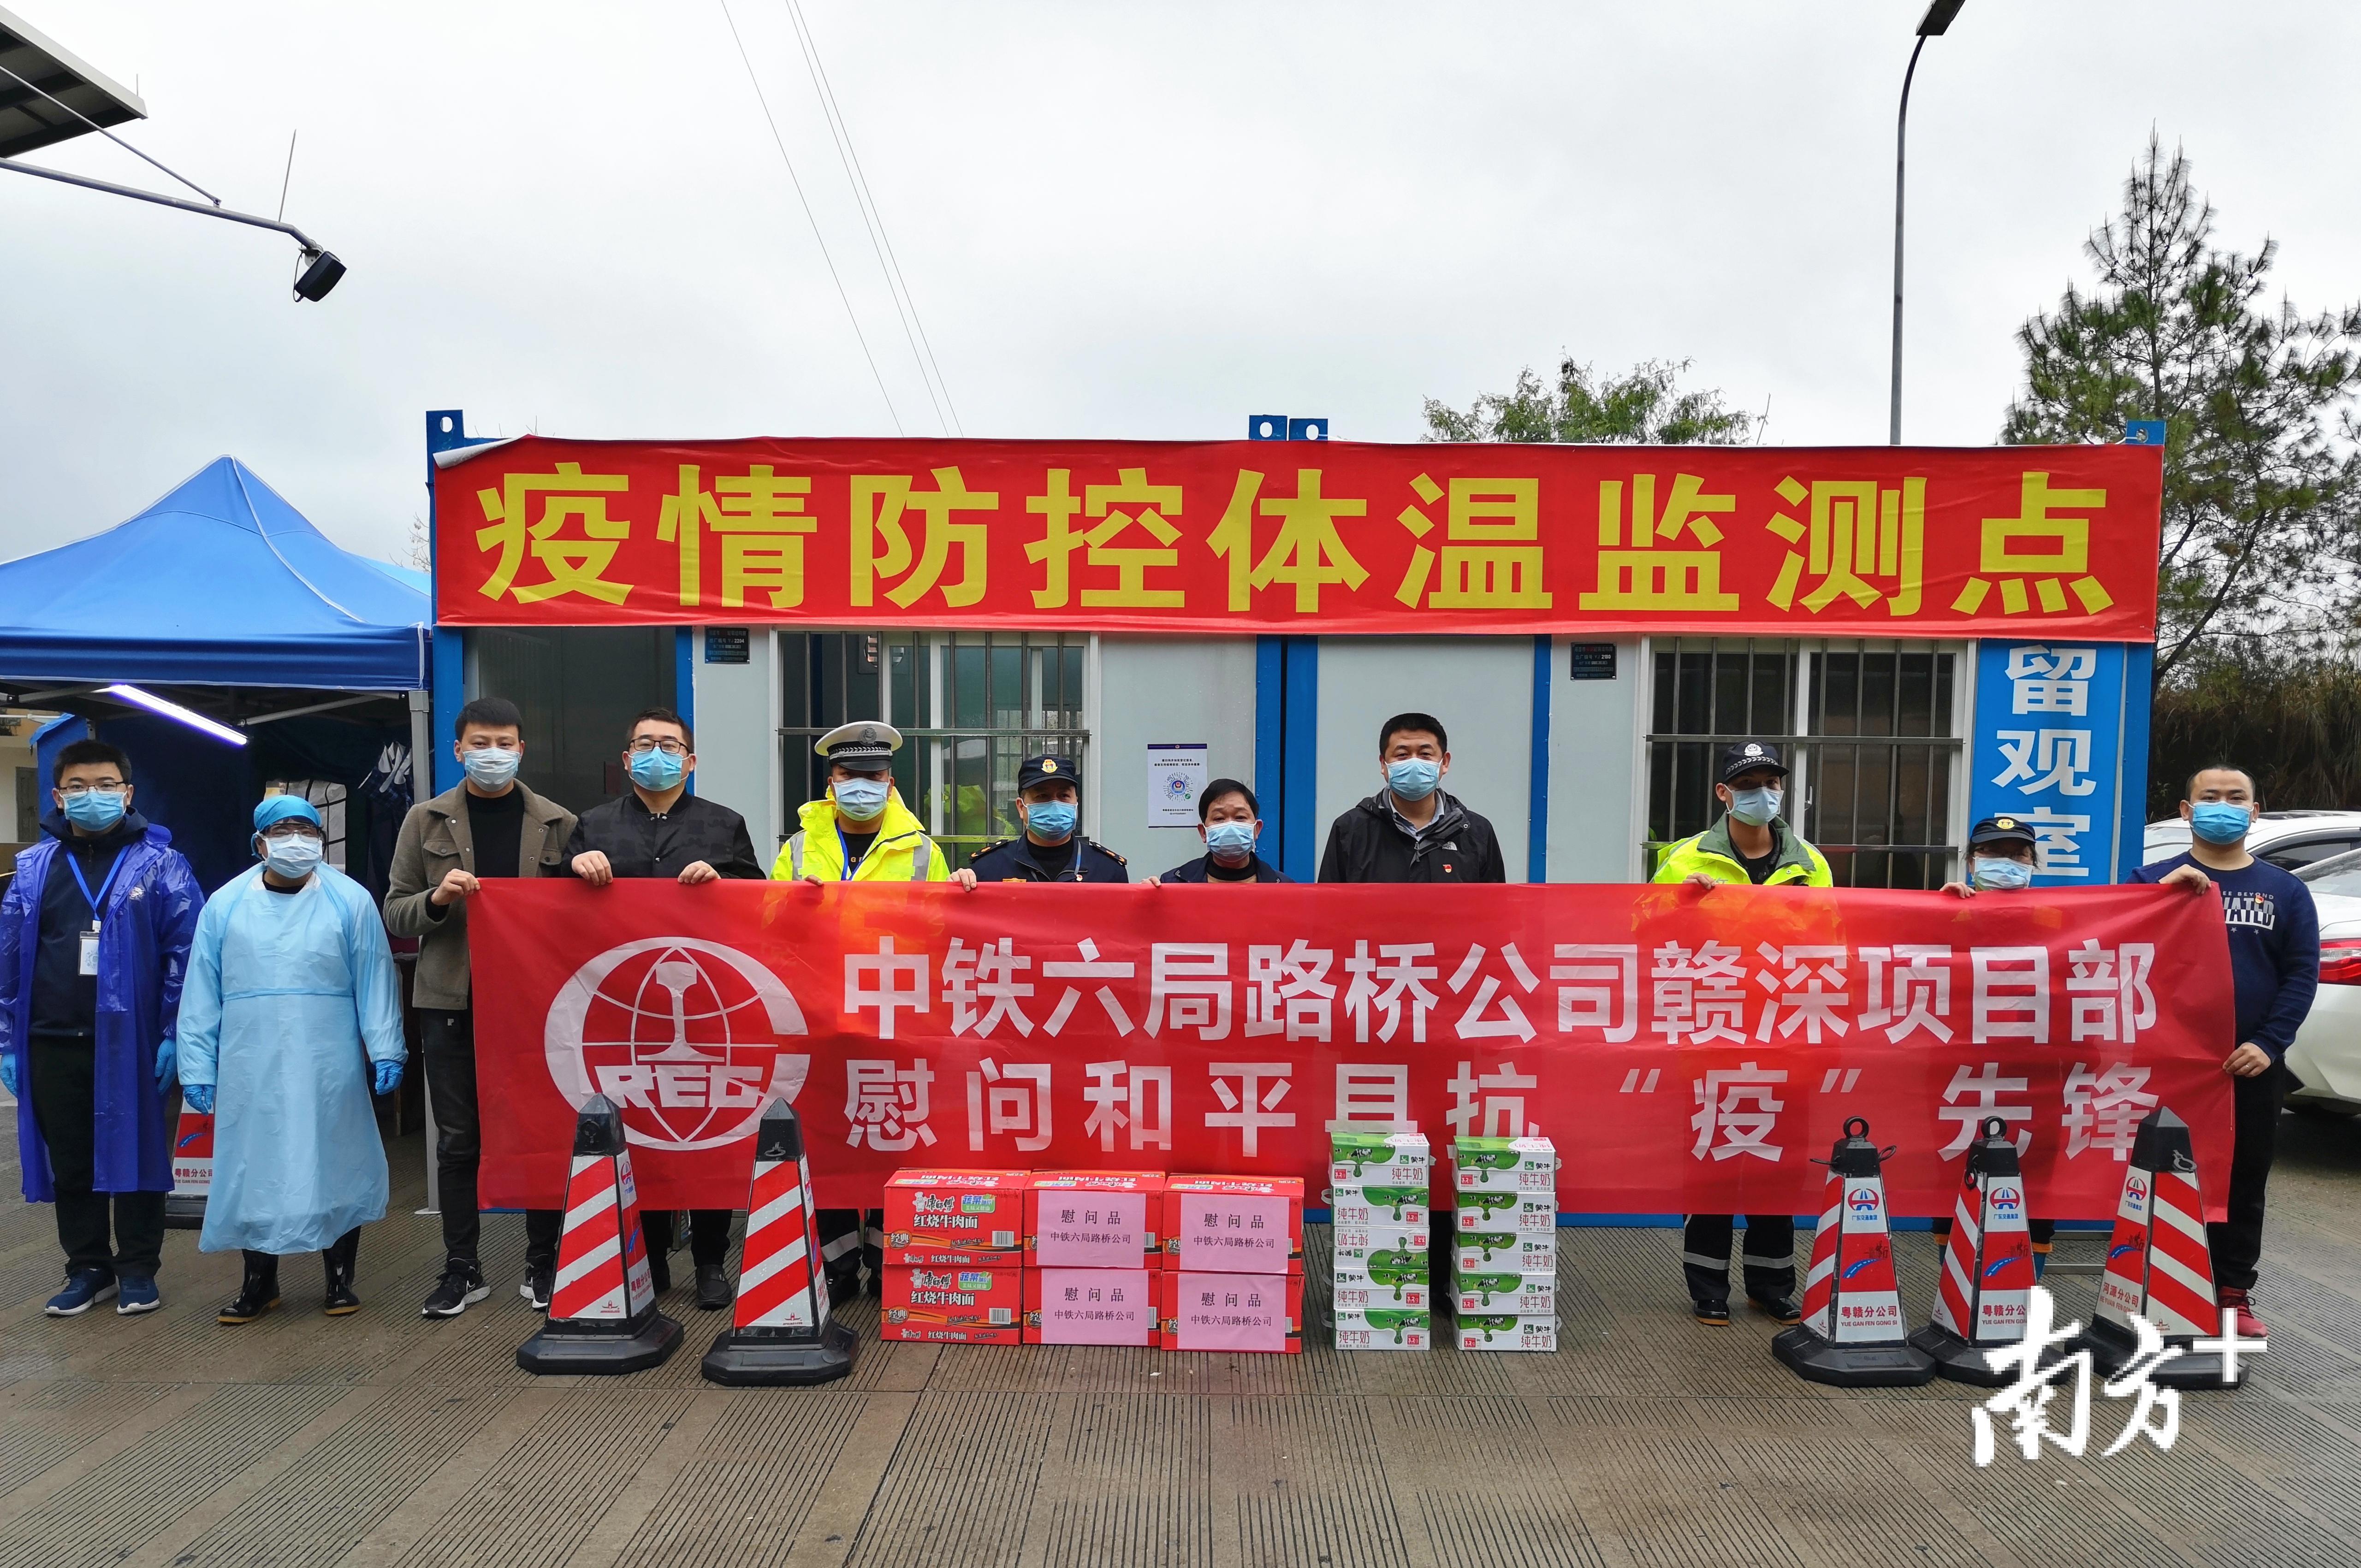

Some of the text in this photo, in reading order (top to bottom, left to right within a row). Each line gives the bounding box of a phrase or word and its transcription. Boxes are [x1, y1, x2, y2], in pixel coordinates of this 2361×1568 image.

[475, 462, 2116, 616] 疫情防控体温监测点
[1991, 645, 2097, 877] 留观室
[843, 936, 2157, 1045] 中铁六局路桥公司赣深项目部
[1392, 1168, 1423, 1180] 纯牛奶
[1519, 1173, 1550, 1186] 纯牛奶
[1061, 1209, 1121, 1225] 慰问品
[1338, 1207, 1368, 1220] 纯牛奶
[914, 1214, 978, 1229] 红烧牛肉面
[1204, 1213, 1264, 1229] 慰问品
[1519, 1214, 1550, 1227] 纯牛奶
[890, 1233, 909, 1243] 经典
[1050, 1231, 1131, 1244] 中铁六局路桥公司
[1193, 1236, 1275, 1248] 中铁六局路桥公司
[931, 1254, 970, 1264] 红烧牛肉面
[1522, 1254, 1553, 1267] 纯牛奶
[911, 1291, 975, 1306] 红烧牛肉面
[1064, 1287, 1124, 1302] 慰问品
[1201, 1292, 1261, 1308] 慰问品
[1338, 1290, 1369, 1303] 纯牛奶
[2103, 1282, 2139, 1308] 河源分公司
[1520, 1296, 1551, 1308] 纯牛奶
[888, 1309, 908, 1319] 经典
[1054, 1310, 1134, 1321] 中铁六局路桥公司
[1841, 1306, 1897, 1318] 粤赣分公司
[1191, 1314, 1272, 1326] 中铁六局路桥公司
[928, 1331, 967, 1340] 红烧牛肉面
[1339, 1331, 1370, 1343] 纯牛奶
[1521, 1335, 1552, 1348] 纯牛奶
